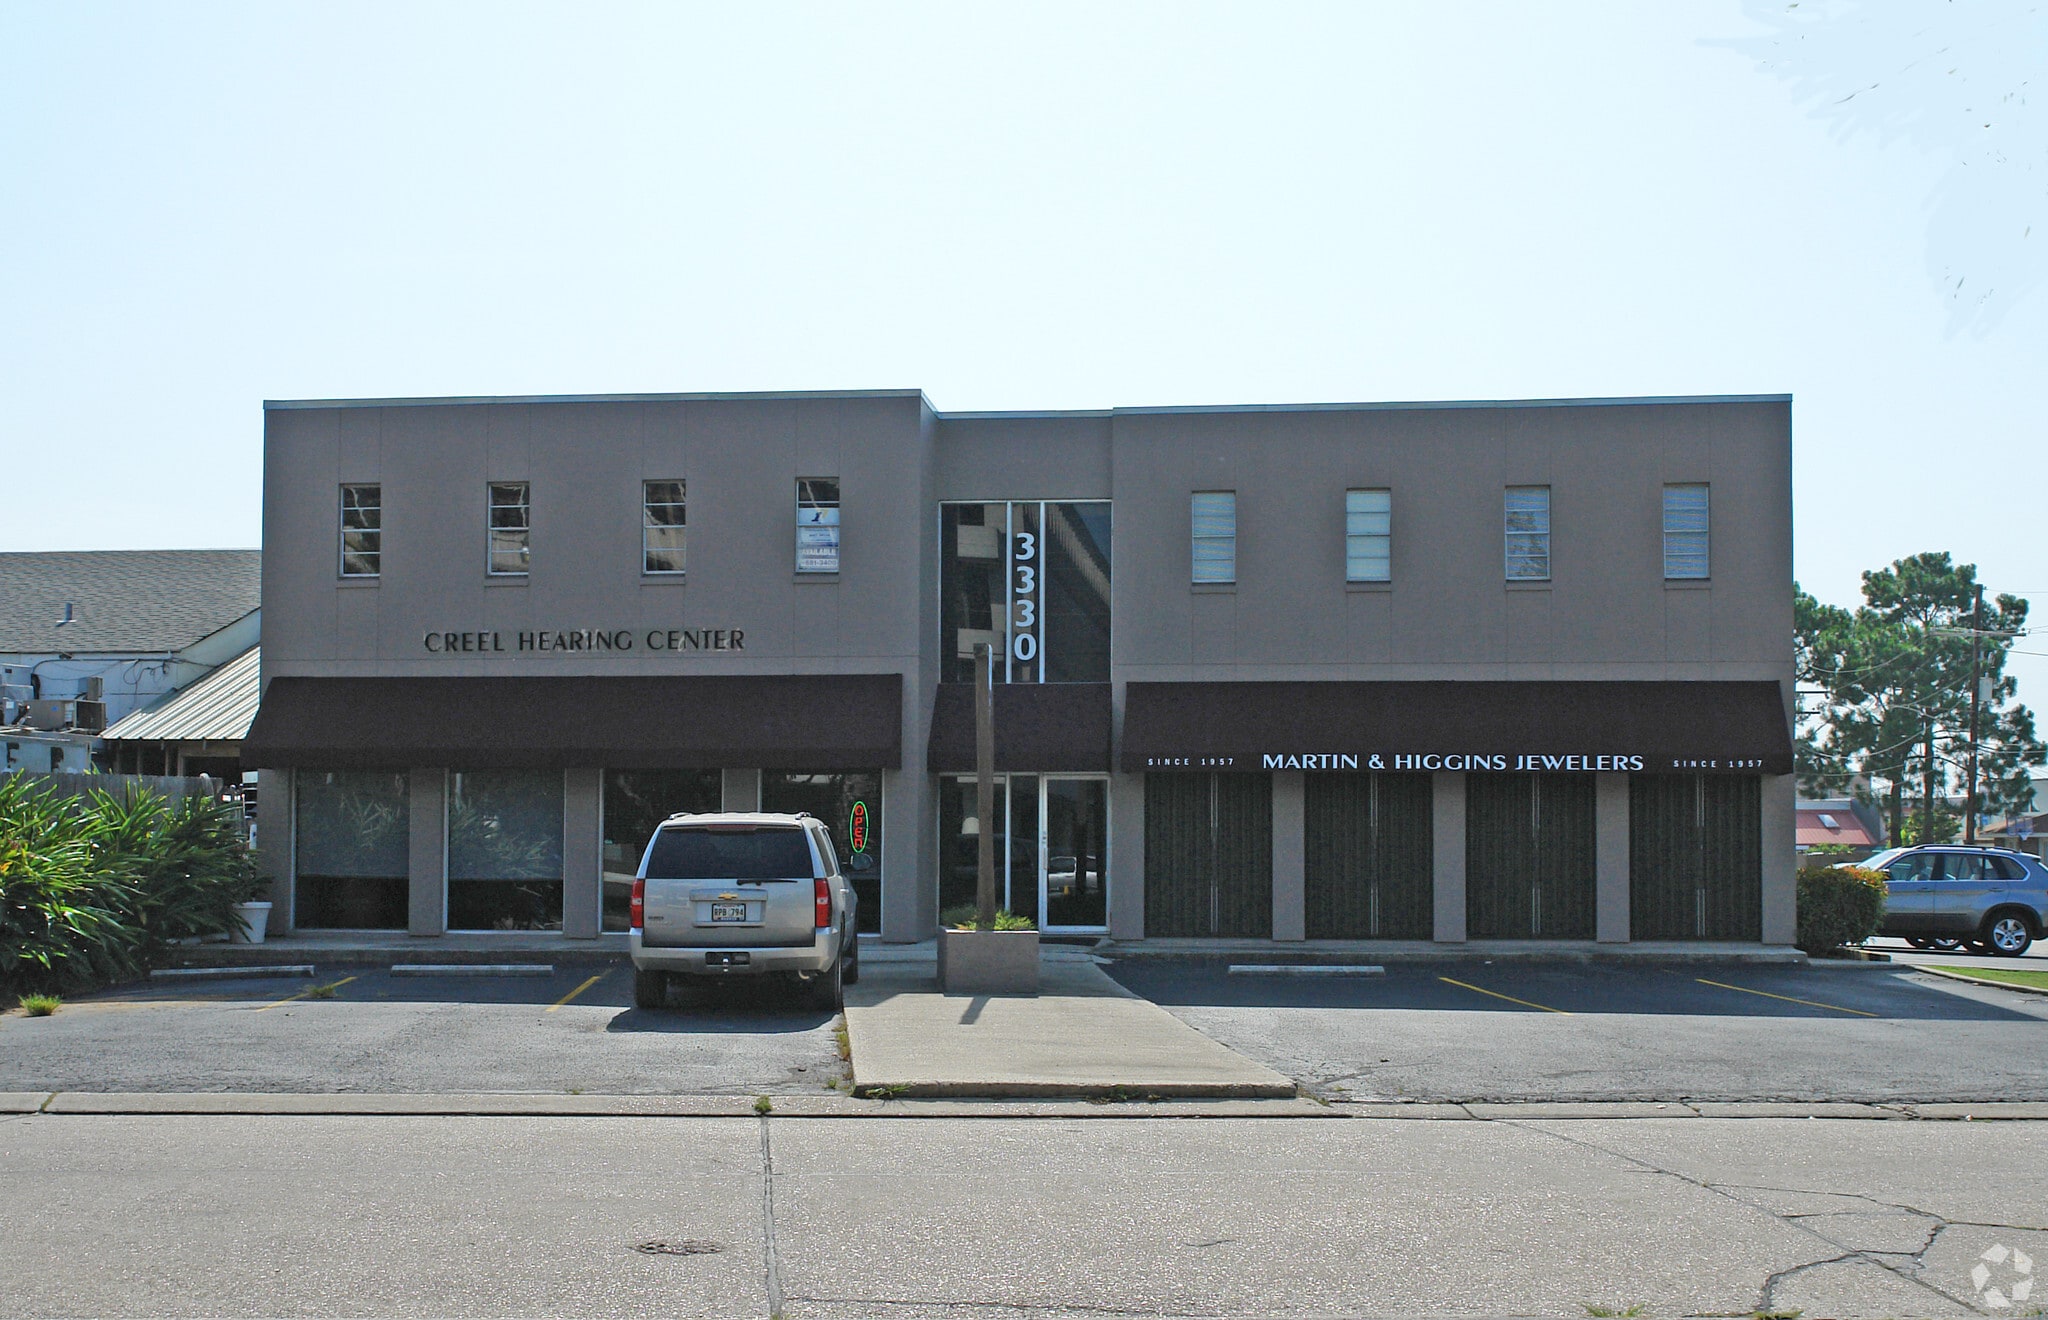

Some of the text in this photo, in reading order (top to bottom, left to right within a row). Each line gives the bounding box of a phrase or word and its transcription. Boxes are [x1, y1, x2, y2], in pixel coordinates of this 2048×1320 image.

[1014, 532, 1037, 661] 3330
[424, 629, 745, 652] CREEL HEARING CENTER
[1148, 758, 1234, 766] SINCE 1957
[1263, 753, 1644, 771] MARTIN & HIGGINS JEWELERS
[1673, 759, 1763, 768] SINCE 1957
[854, 804, 865, 849] OPEN
